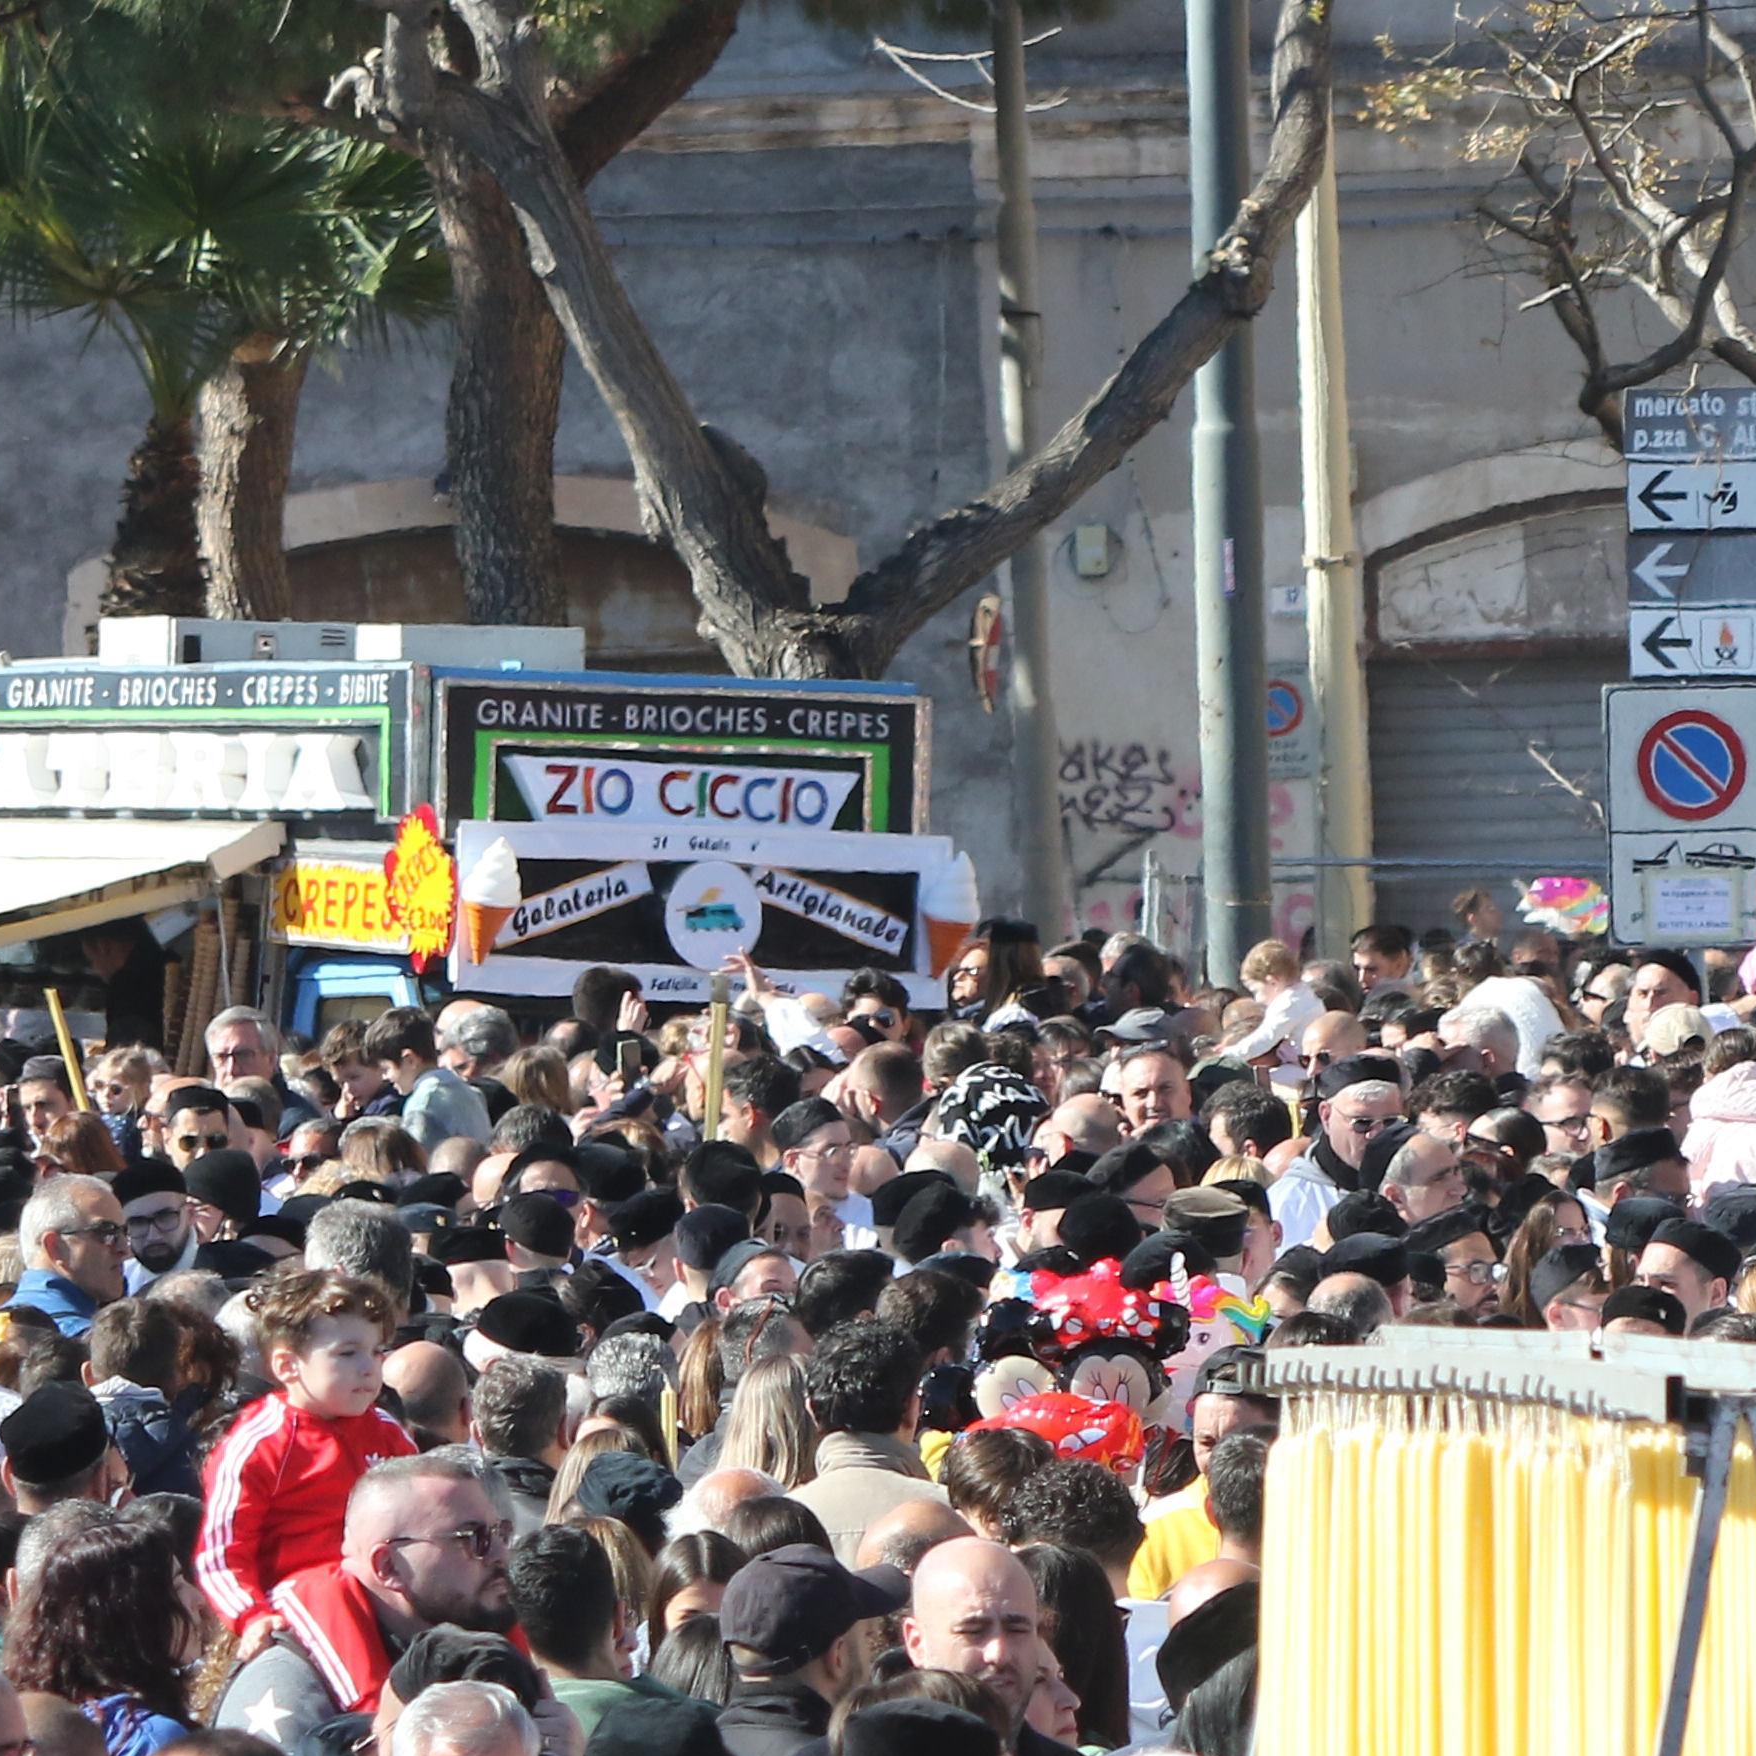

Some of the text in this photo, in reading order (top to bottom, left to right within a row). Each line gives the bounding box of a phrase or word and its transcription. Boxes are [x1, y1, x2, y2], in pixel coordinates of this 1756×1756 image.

[1635, 391, 1724, 417] mercato
[1633, 428, 1687, 451] p.zza
[6, 677, 95, 708] GRANITE
[118, 676, 218, 706] BRIOCHES
[242, 675, 319, 705] CREPES
[338, 674, 389, 704] BIBITE
[476, 698, 891, 739] GRANITE BRIOCHES CREPES
[545, 764, 829, 826] ZIO CICCIO
[513, 877, 629, 937] Gelateria
[755, 870, 900, 943] Artigianale
